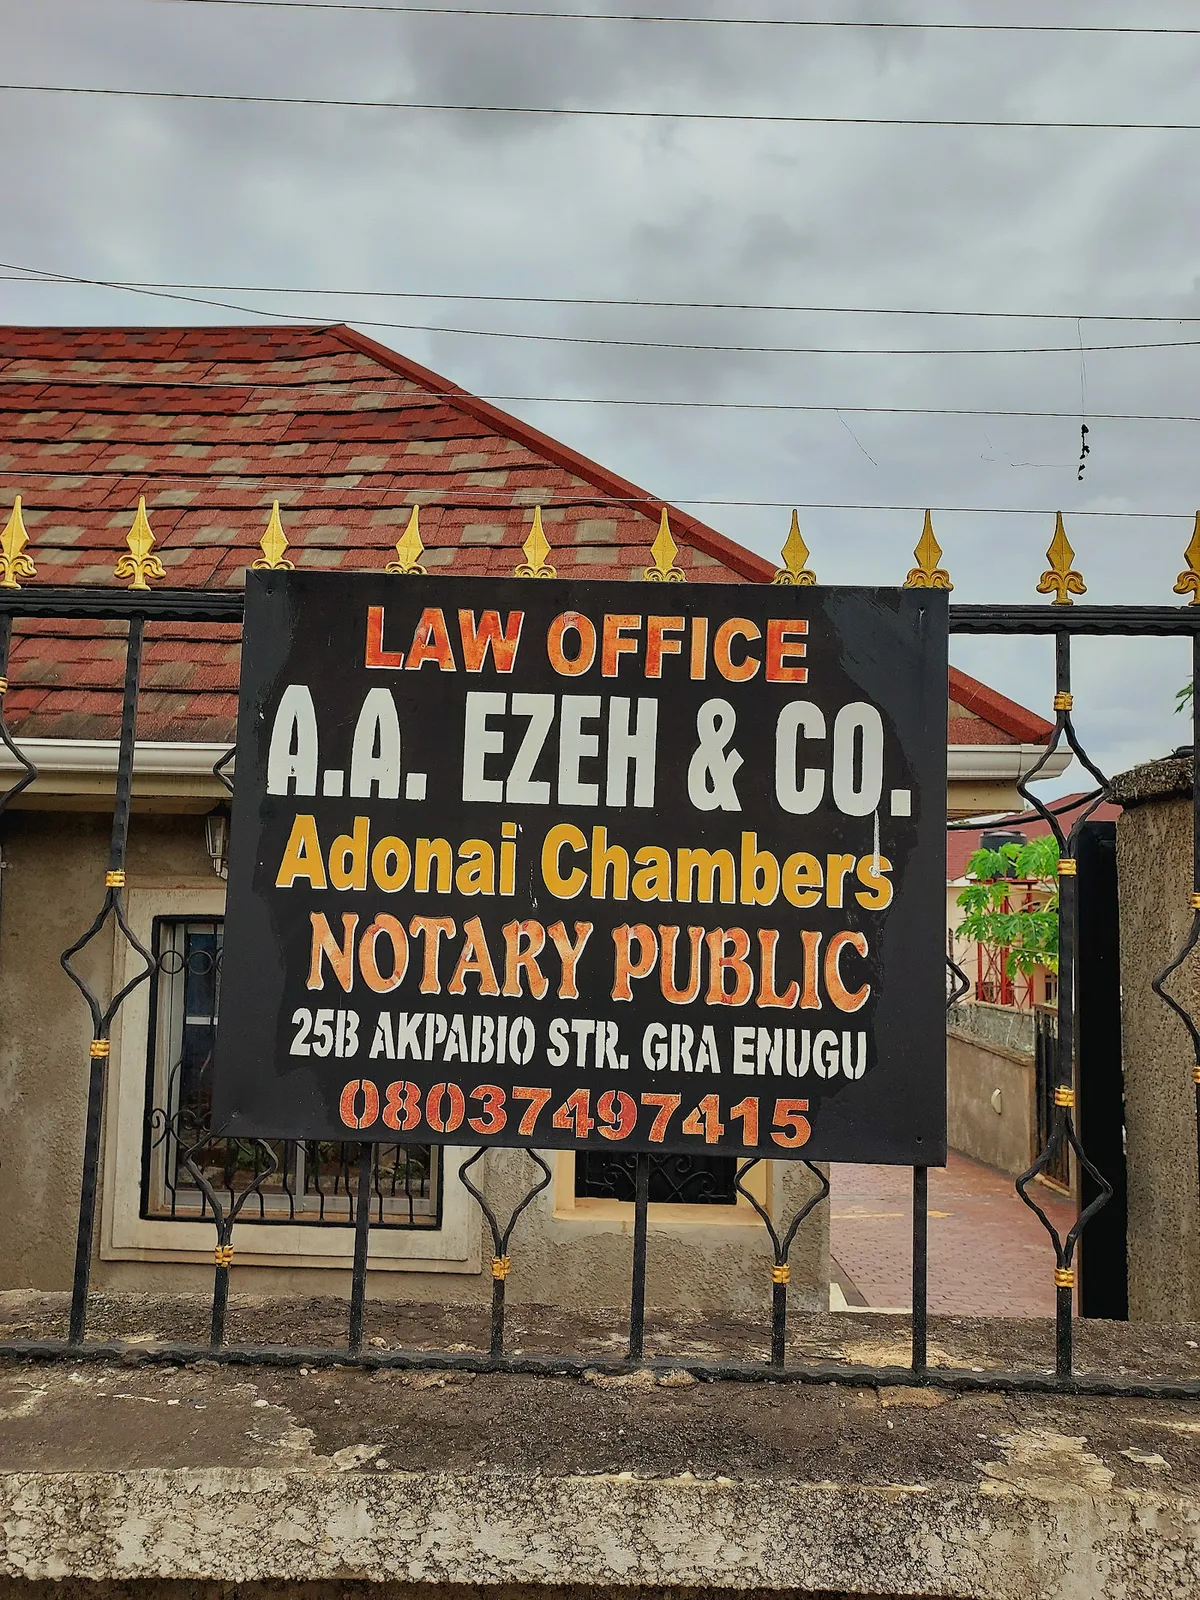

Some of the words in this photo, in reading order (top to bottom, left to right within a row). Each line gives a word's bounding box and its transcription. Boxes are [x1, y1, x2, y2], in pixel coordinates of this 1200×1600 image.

[364, 606, 526, 675] LAW
[546, 610, 809, 684] OFFICE
[266, 684, 428, 802] A.A.
[461, 691, 659, 809] EZEH
[687, 698, 745, 812] &
[775, 700, 912, 818] CO.
[274, 813, 518, 898] Adonai
[541, 822, 894, 911] Chambers
[306, 911, 594, 1001] NOTARY
[610, 922, 872, 1013] PUBLIC
[289, 1007, 360, 1059] 25B
[368, 1010, 536, 1066] AKPABIO
[546, 1017, 629, 1071] STR.
[642, 1022, 722, 1075] GRA
[733, 1026, 867, 1081] ENUGU
[338, 1078, 812, 1149] 08037497415
